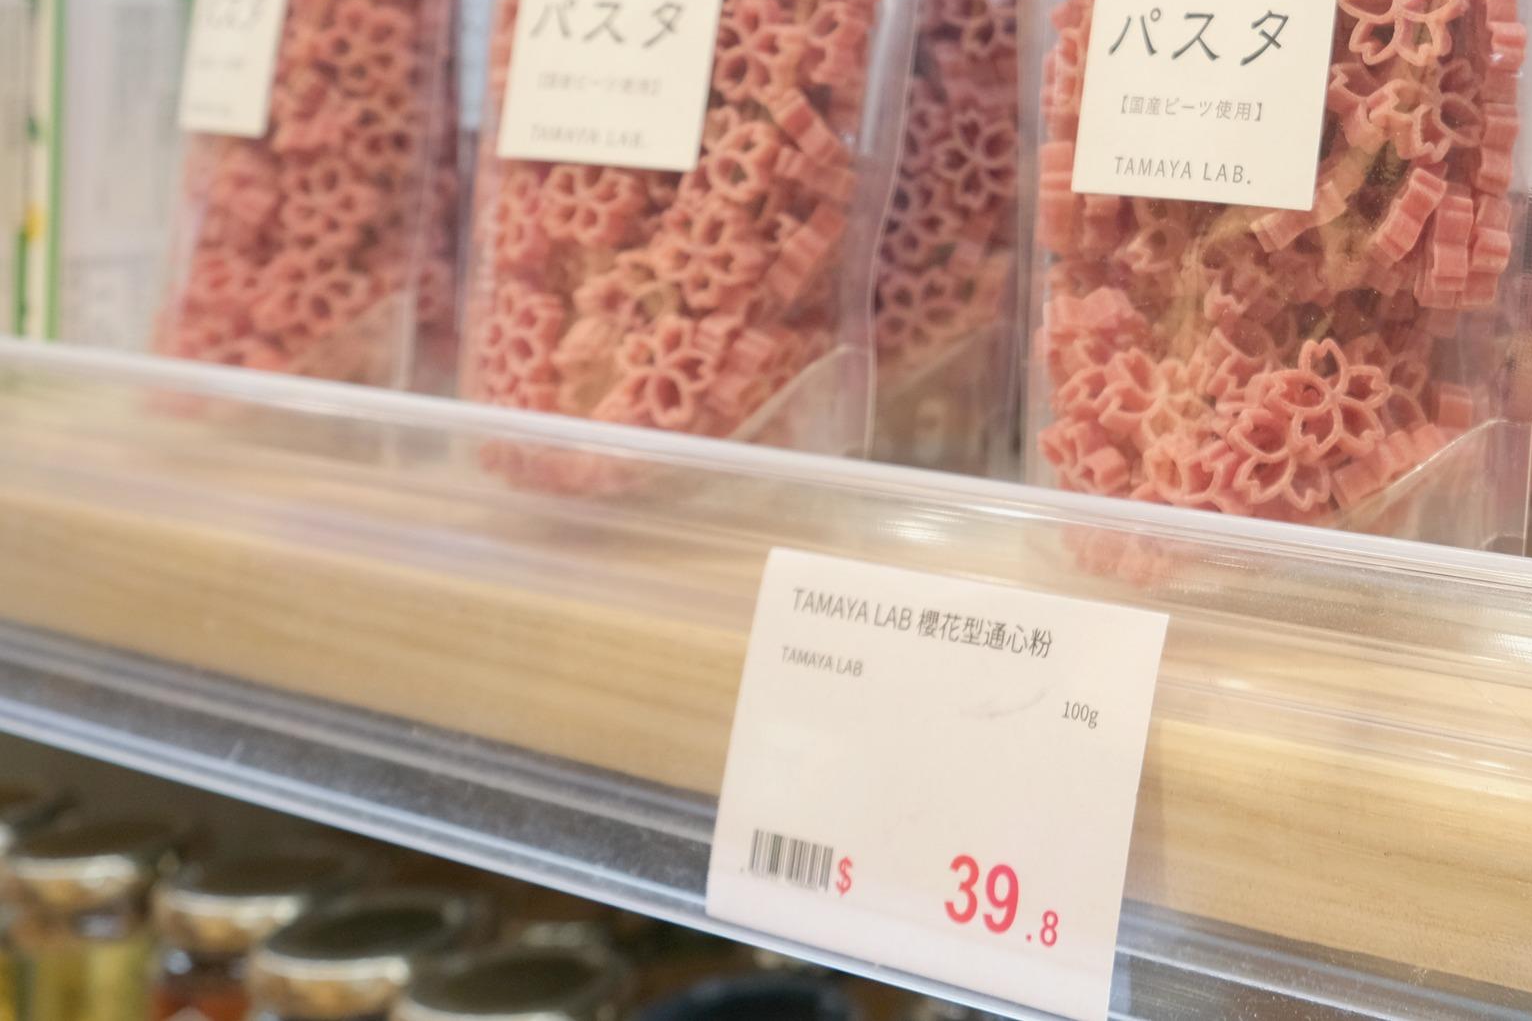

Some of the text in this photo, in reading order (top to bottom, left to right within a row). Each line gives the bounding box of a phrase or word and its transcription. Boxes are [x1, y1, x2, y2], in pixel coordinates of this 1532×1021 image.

[1107, 7, 1291, 67] パスタ
[1119, 93, 1265, 123] 【国産ビーツ使用】
[1114, 155, 1253, 186] TAMAYA LAB.
[792, 587, 1053, 659] TAMAYA LAB 櫻花型通心粉
[781, 645, 864, 678] TAMAYA LAB
[1061, 699, 1099, 730] 100g
[835, 855, 854, 898] $
